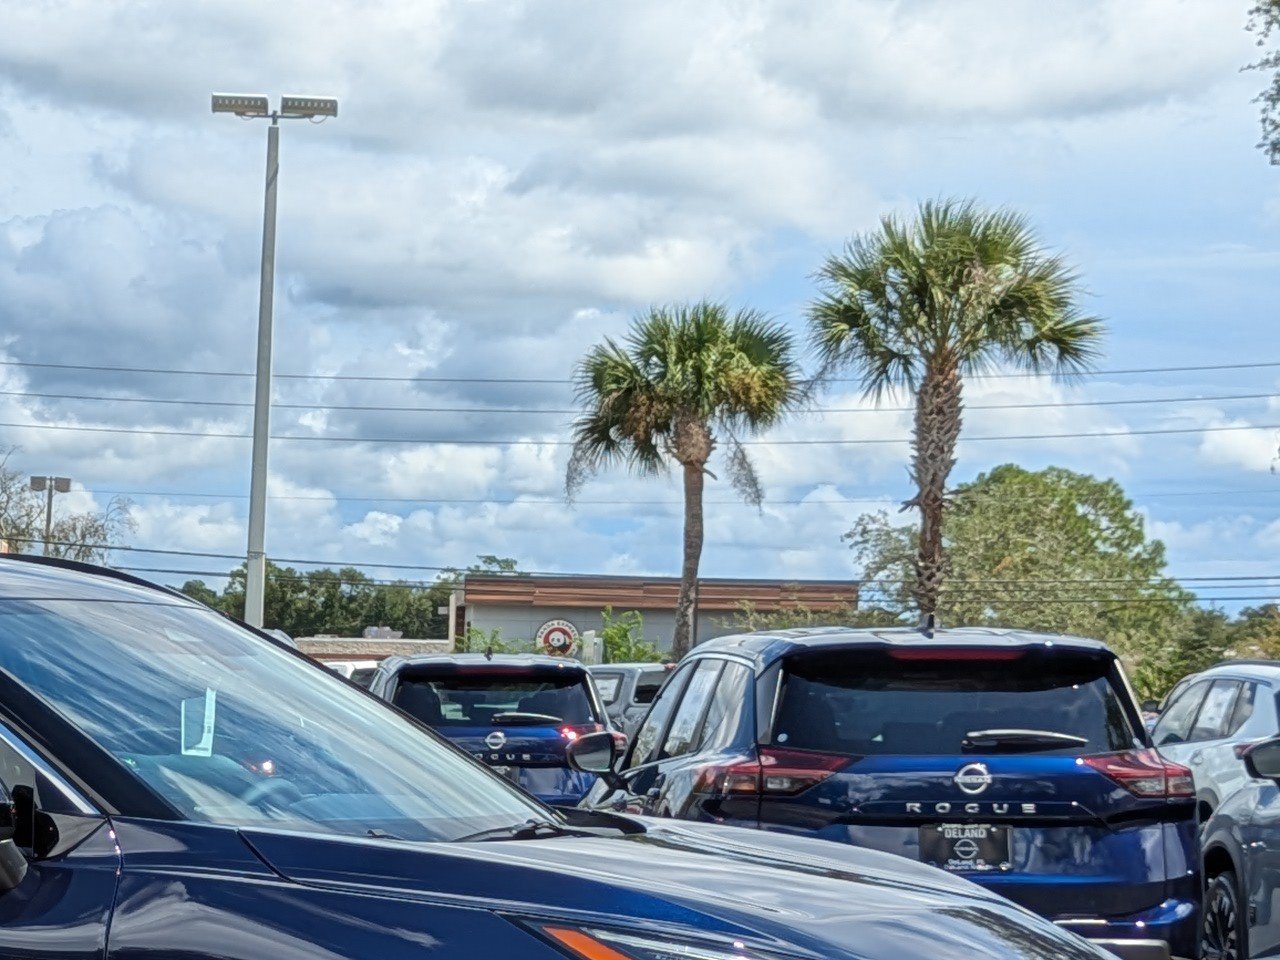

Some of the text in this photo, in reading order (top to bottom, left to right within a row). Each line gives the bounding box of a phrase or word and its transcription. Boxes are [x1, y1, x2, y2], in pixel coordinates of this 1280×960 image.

[474, 752, 531, 760] OGUE
[905, 802, 1037, 814] ROGUE
[944, 828, 988, 839] DELAND
